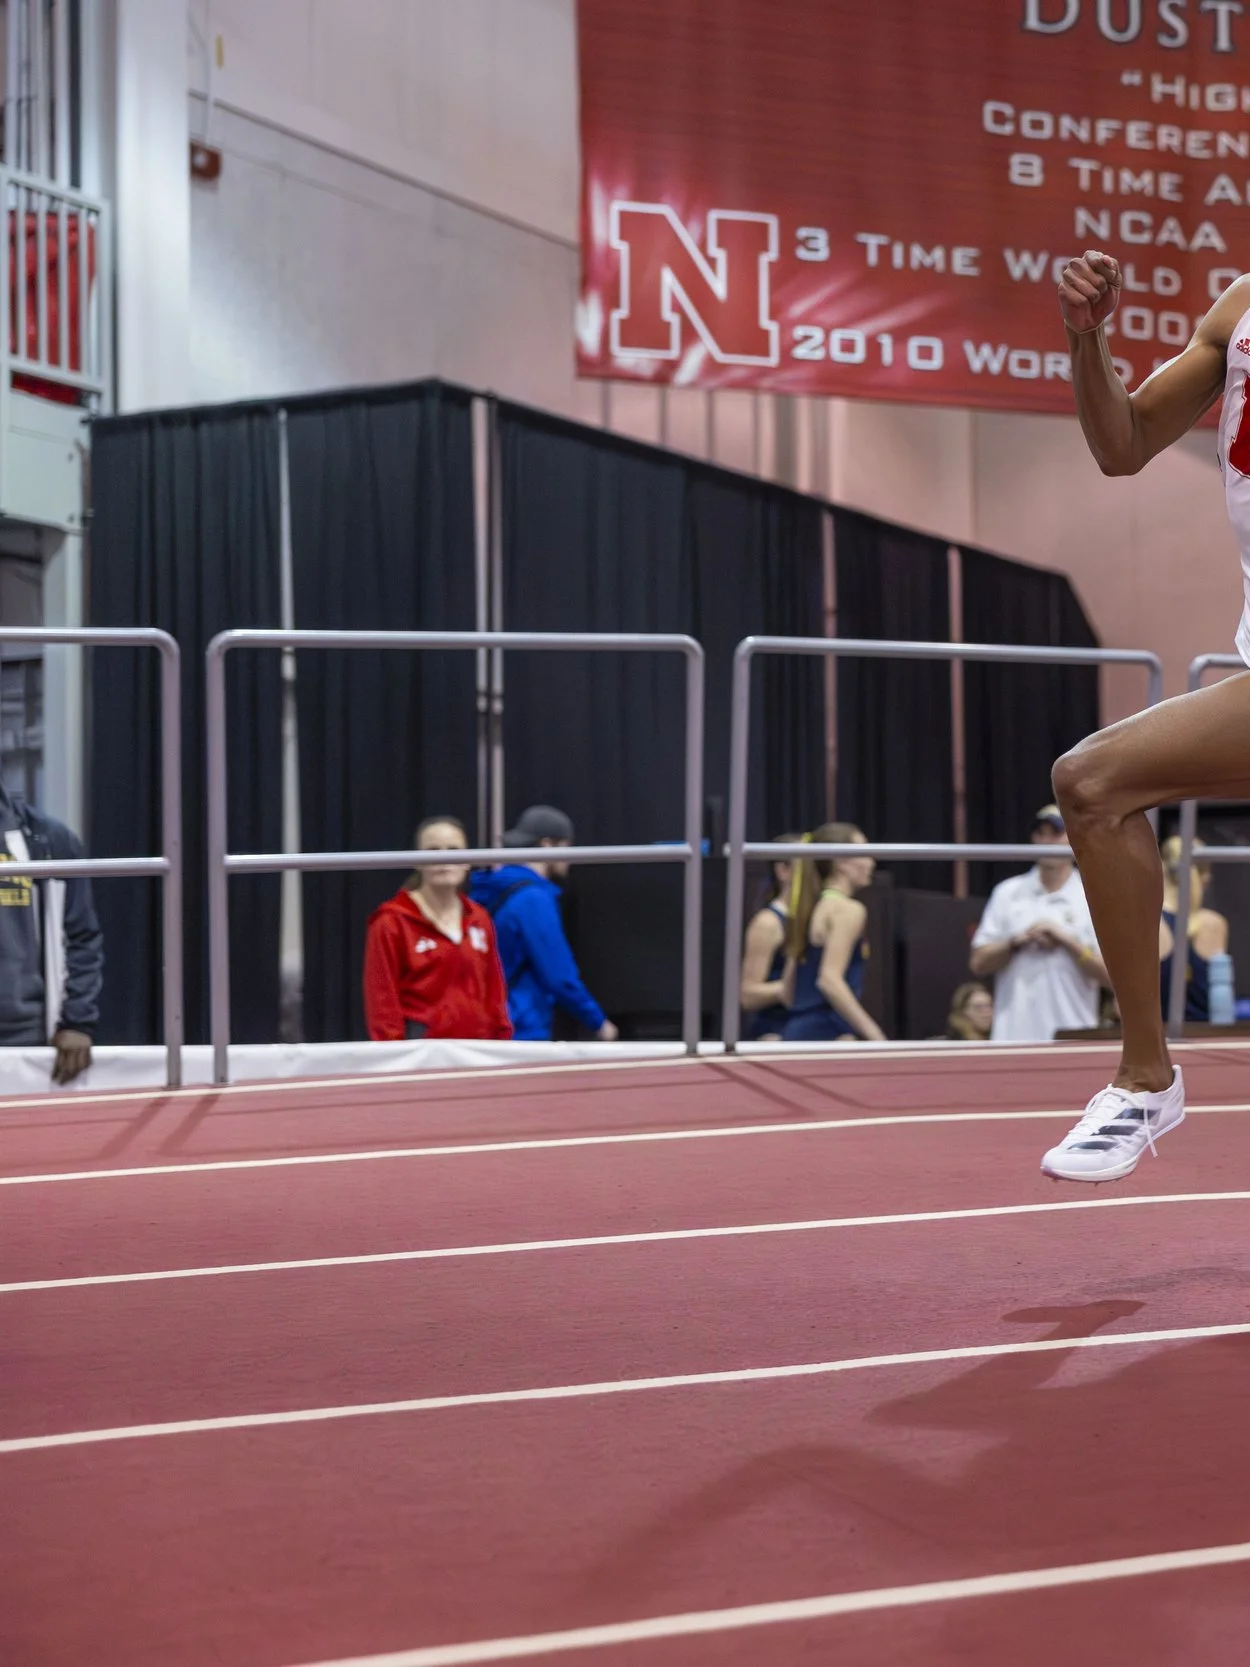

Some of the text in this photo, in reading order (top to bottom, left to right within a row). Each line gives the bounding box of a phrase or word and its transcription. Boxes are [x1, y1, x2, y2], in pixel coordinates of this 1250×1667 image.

[1008, 152, 1044, 187] 8
[1068, 157, 1185, 203] TIME
[1074, 206, 1228, 253] NCAA
[609, 199, 780, 367] N
[794, 227, 830, 263] 3
[855, 231, 981, 277] TIME
[1003, 249, 1182, 296] WOLD
[791, 325, 944, 372] 2010
[962, 339, 1134, 386] WORD
